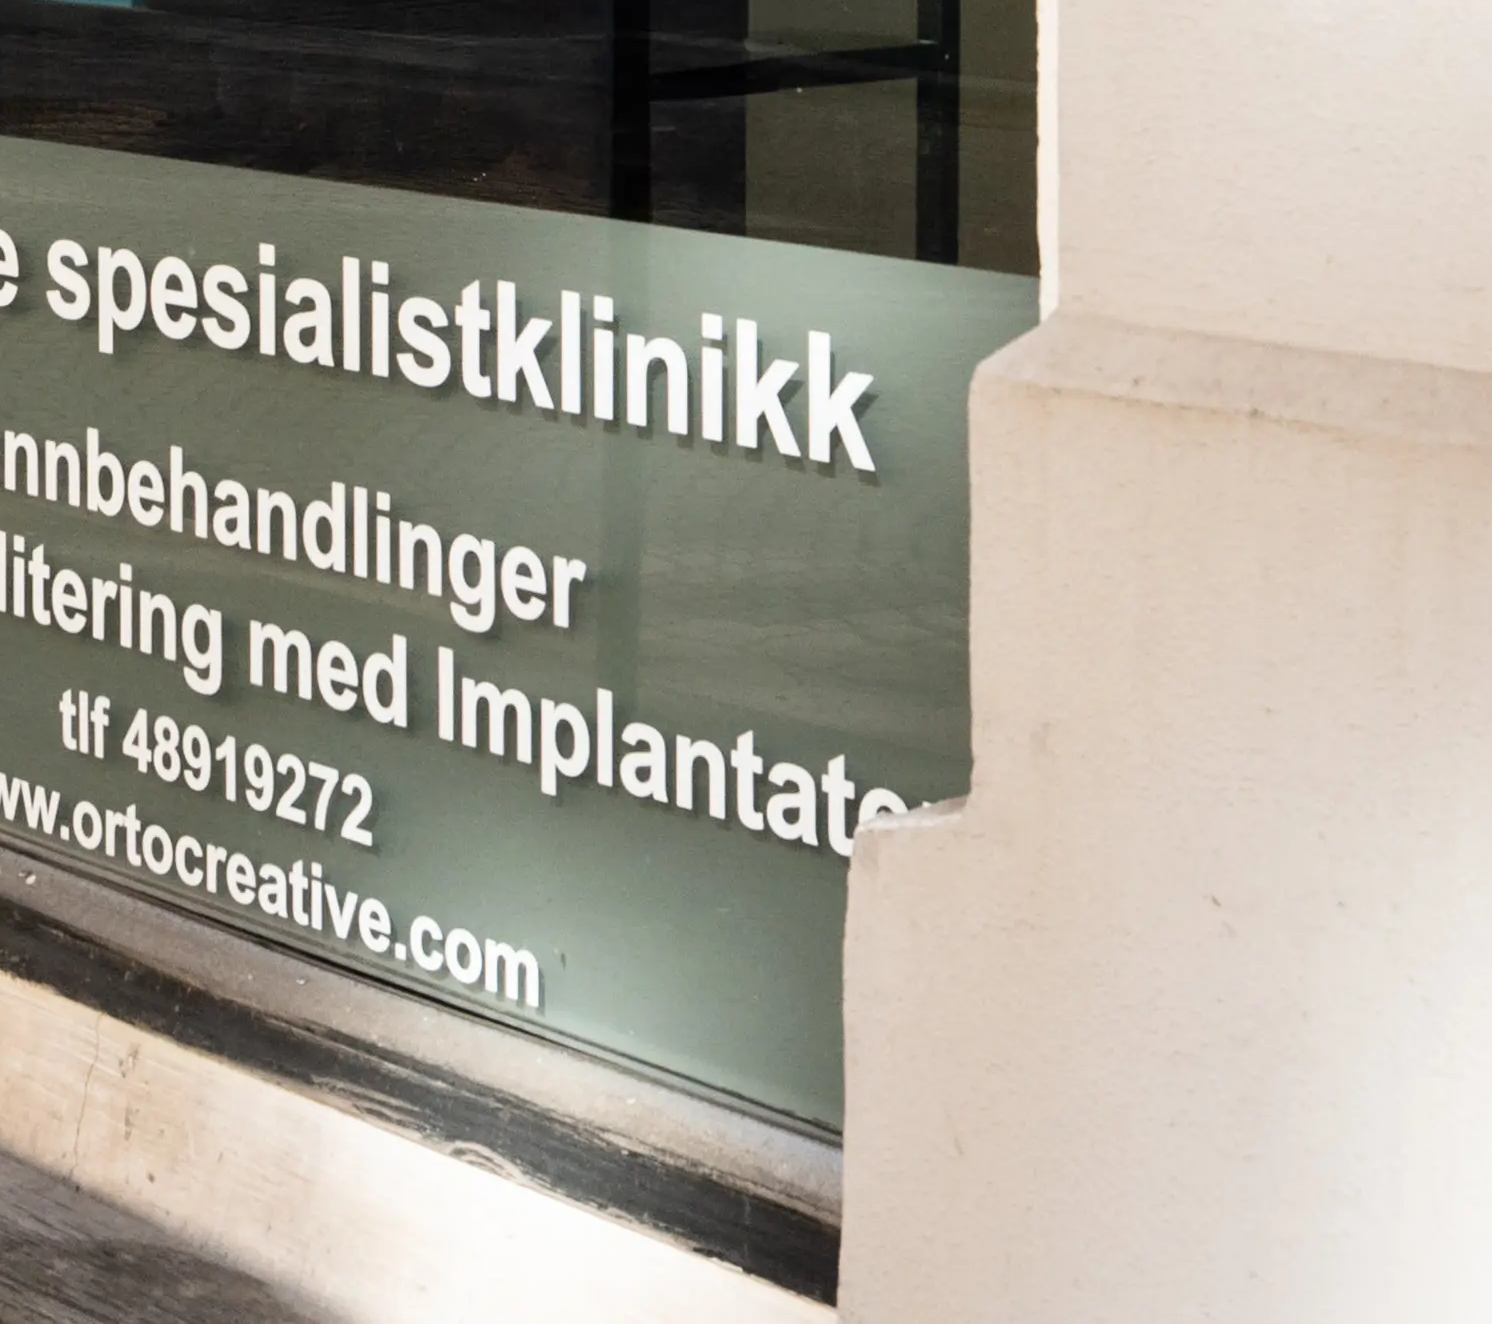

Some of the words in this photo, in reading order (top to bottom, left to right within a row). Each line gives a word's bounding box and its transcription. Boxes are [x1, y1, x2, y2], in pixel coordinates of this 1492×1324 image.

[45, 238, 876, 473] spesialistklinikk
[58, 688, 111, 760] tlf
[122, 707, 374, 847] 48919272
[248, 618, 408, 729] med
[437, 645, 930, 858] Implantat
